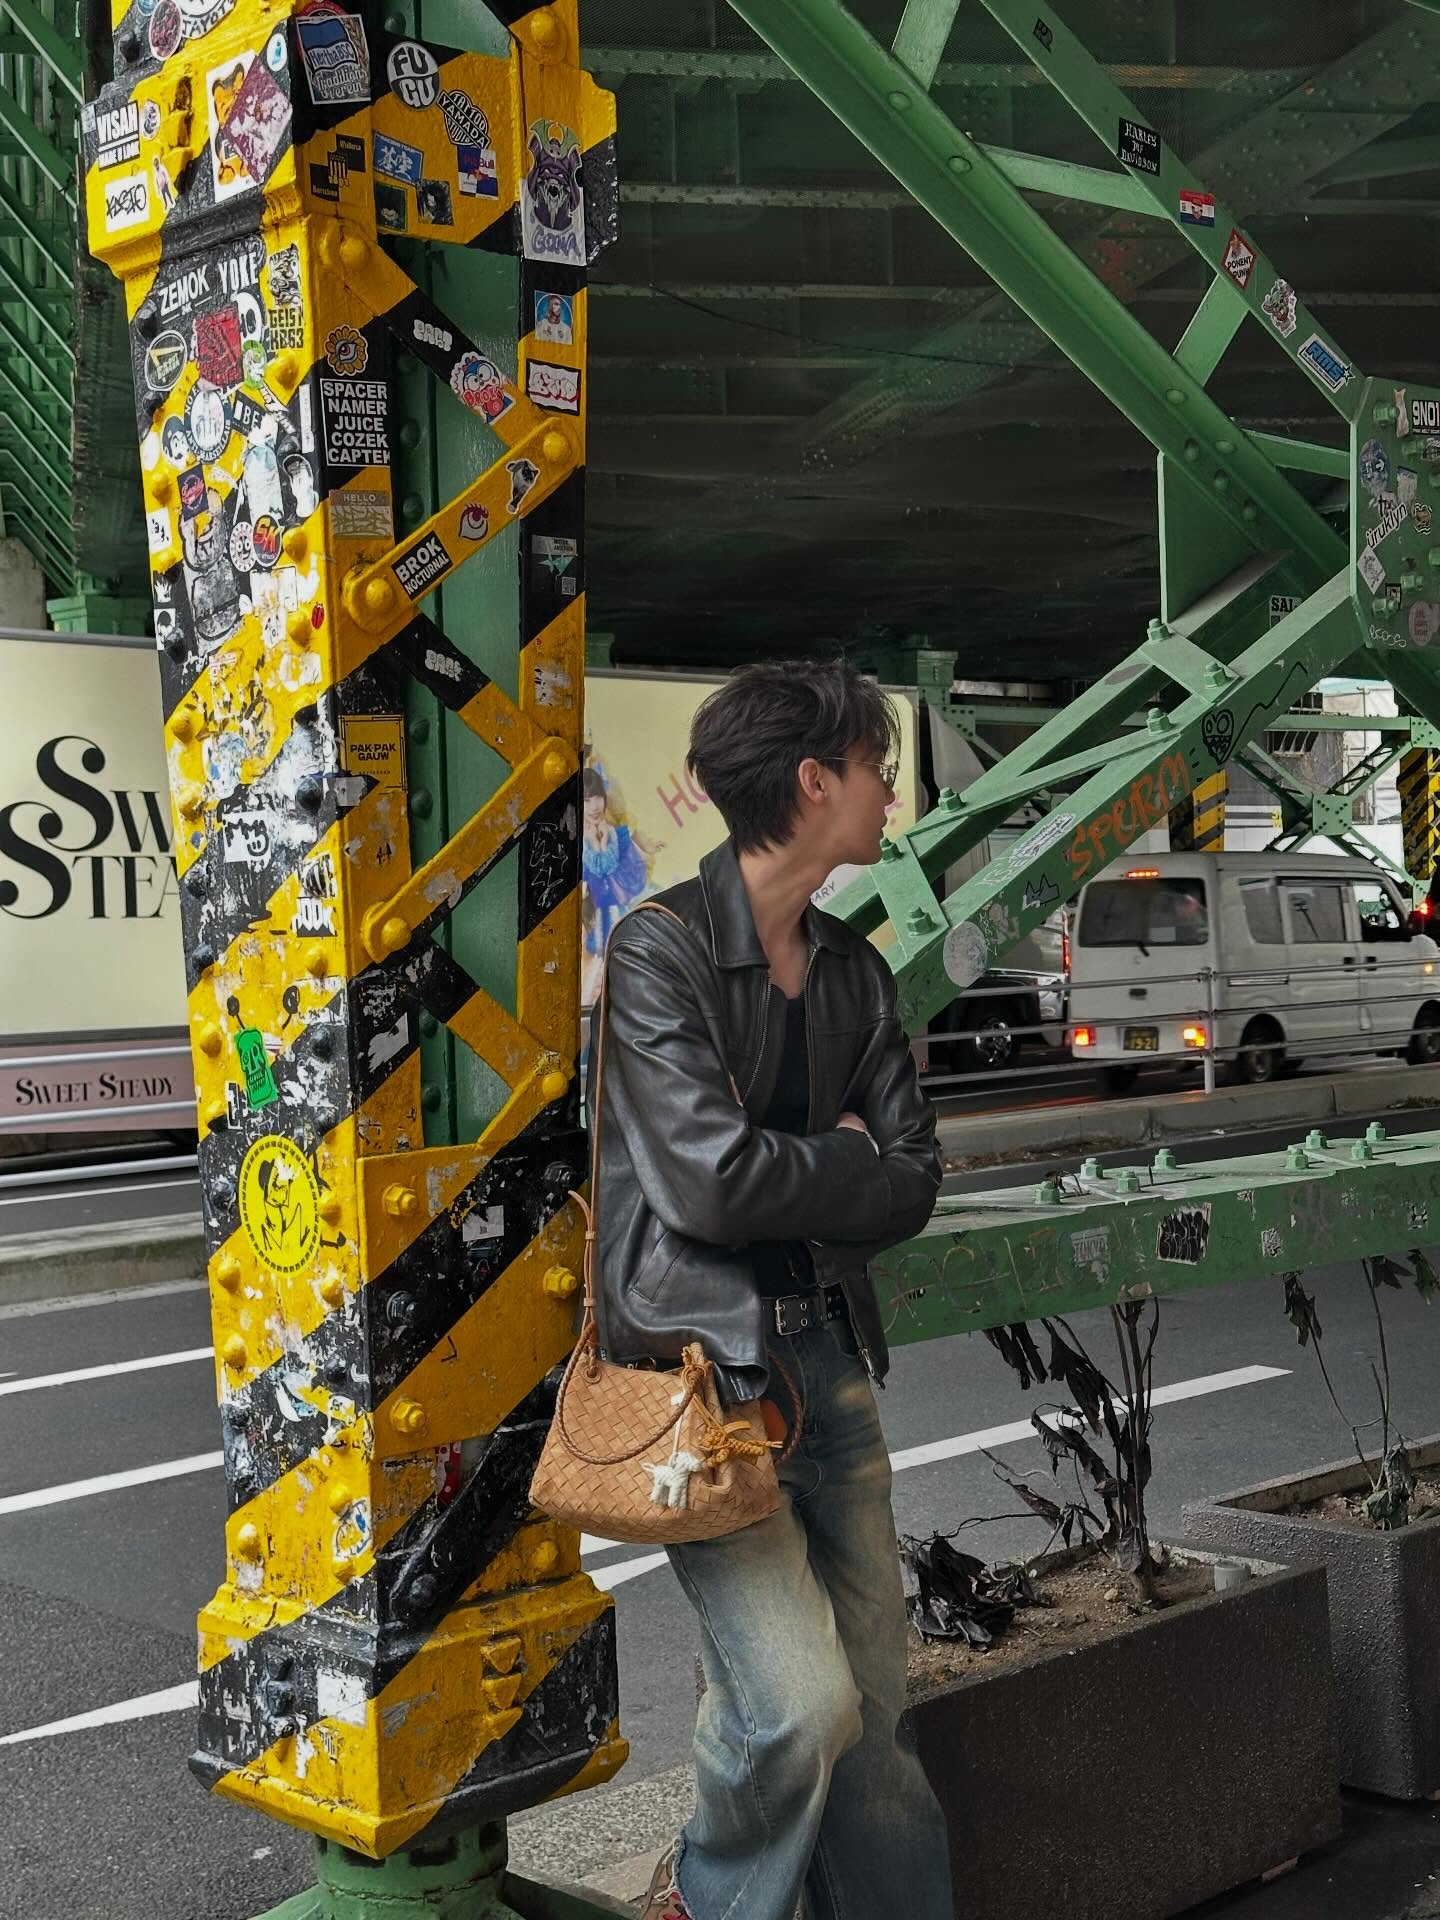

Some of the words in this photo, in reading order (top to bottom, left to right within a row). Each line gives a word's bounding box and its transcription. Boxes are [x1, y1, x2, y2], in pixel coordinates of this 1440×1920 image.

[394, 46, 429, 76] FU
[400, 78, 435, 107] GU
[441, 96, 486, 148] YAMADA
[453, 93, 487, 131] TATTOO
[1124, 122, 1158, 148] HARLEY
[1121, 149, 1158, 172] DAVIDSON
[217, 251, 259, 295] YOKE
[158, 263, 211, 317] ZEMOK
[323, 382, 388, 399] SPACER
[328, 398, 388, 415] NAMER
[334, 415, 385, 432] JUICE
[331, 432, 389, 448] COZEK
[343, 493, 376, 502] HELLO
[395, 536, 443, 583] BROK
[404, 552, 450, 595] NOCTURNAL
[357, 751, 390, 761] GAUW
[15, 1078, 93, 1106] SWEET
[99, 1072, 177, 1101] STEADY
